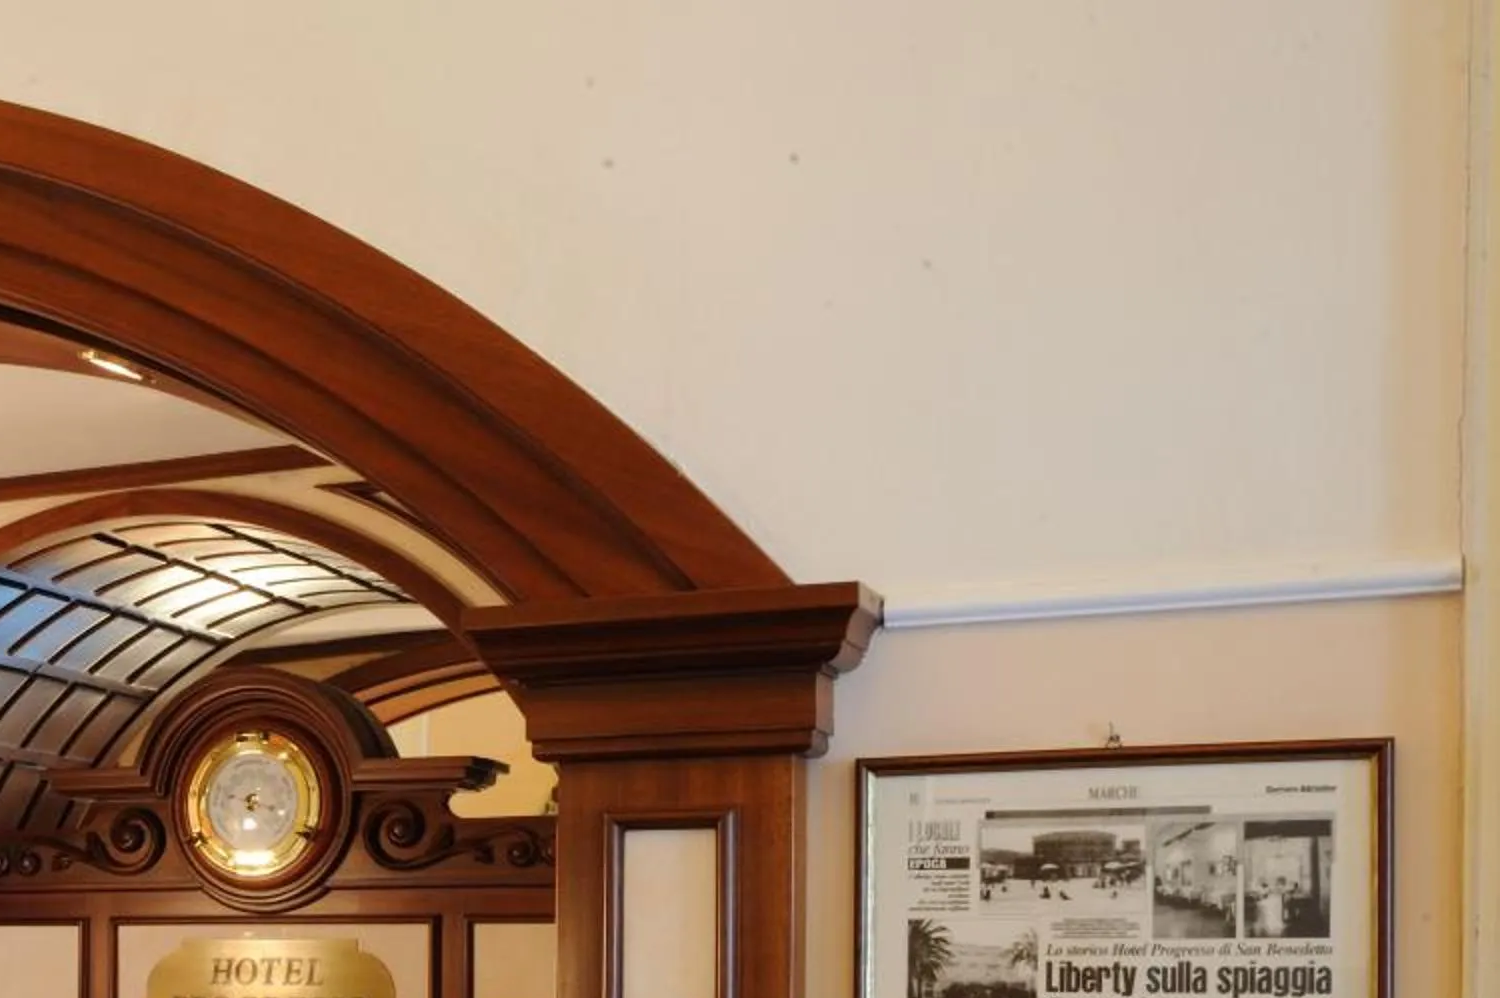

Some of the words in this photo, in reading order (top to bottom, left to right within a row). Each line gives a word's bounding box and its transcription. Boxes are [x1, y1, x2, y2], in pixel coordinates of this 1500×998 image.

[1112, 942, 1149, 957] Hotel
[1151, 941, 1214, 958] Progresso
[1238, 942, 1261, 956] San
[1266, 942, 1333, 956] Benedetto
[208, 957, 324, 987] HOTEL
[1045, 961, 1137, 996] Liberty
[1146, 961, 1208, 994] sulla
[1216, 960, 1333, 998] spiaggia
